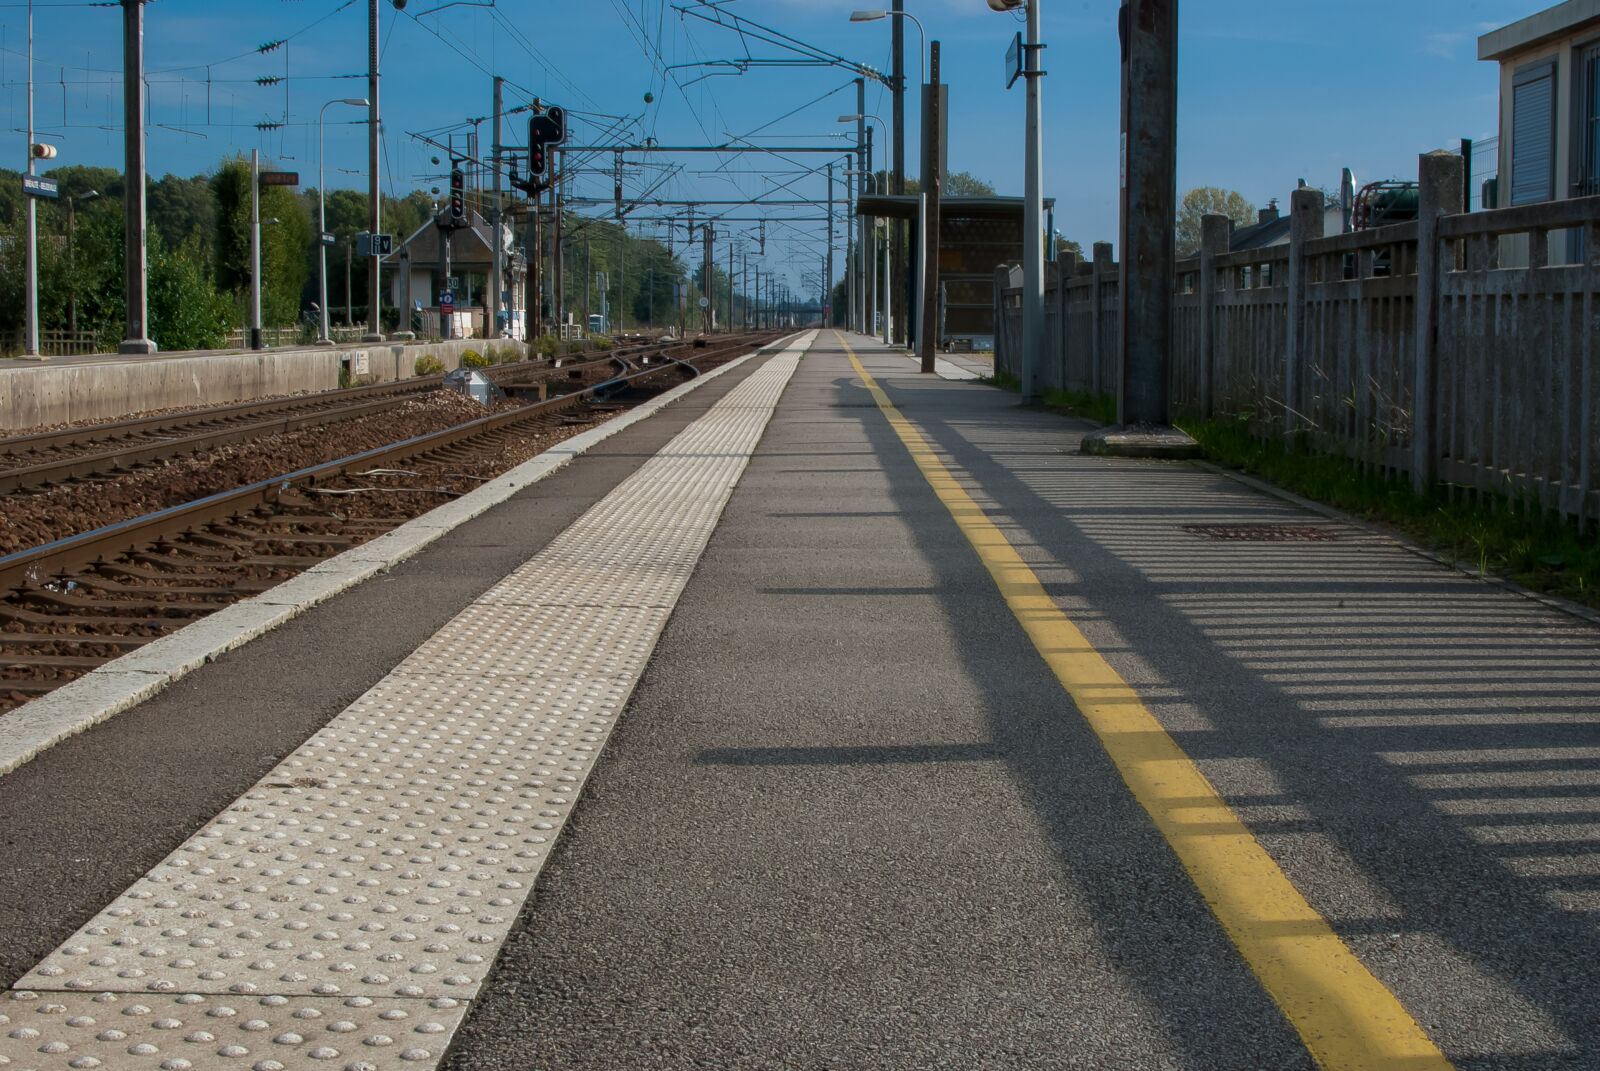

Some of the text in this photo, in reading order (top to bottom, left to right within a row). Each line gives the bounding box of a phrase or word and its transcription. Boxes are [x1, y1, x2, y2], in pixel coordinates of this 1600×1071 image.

[374, 236, 381, 244] 9
[383, 240, 389, 250] V
[448, 279, 458, 288] 30
